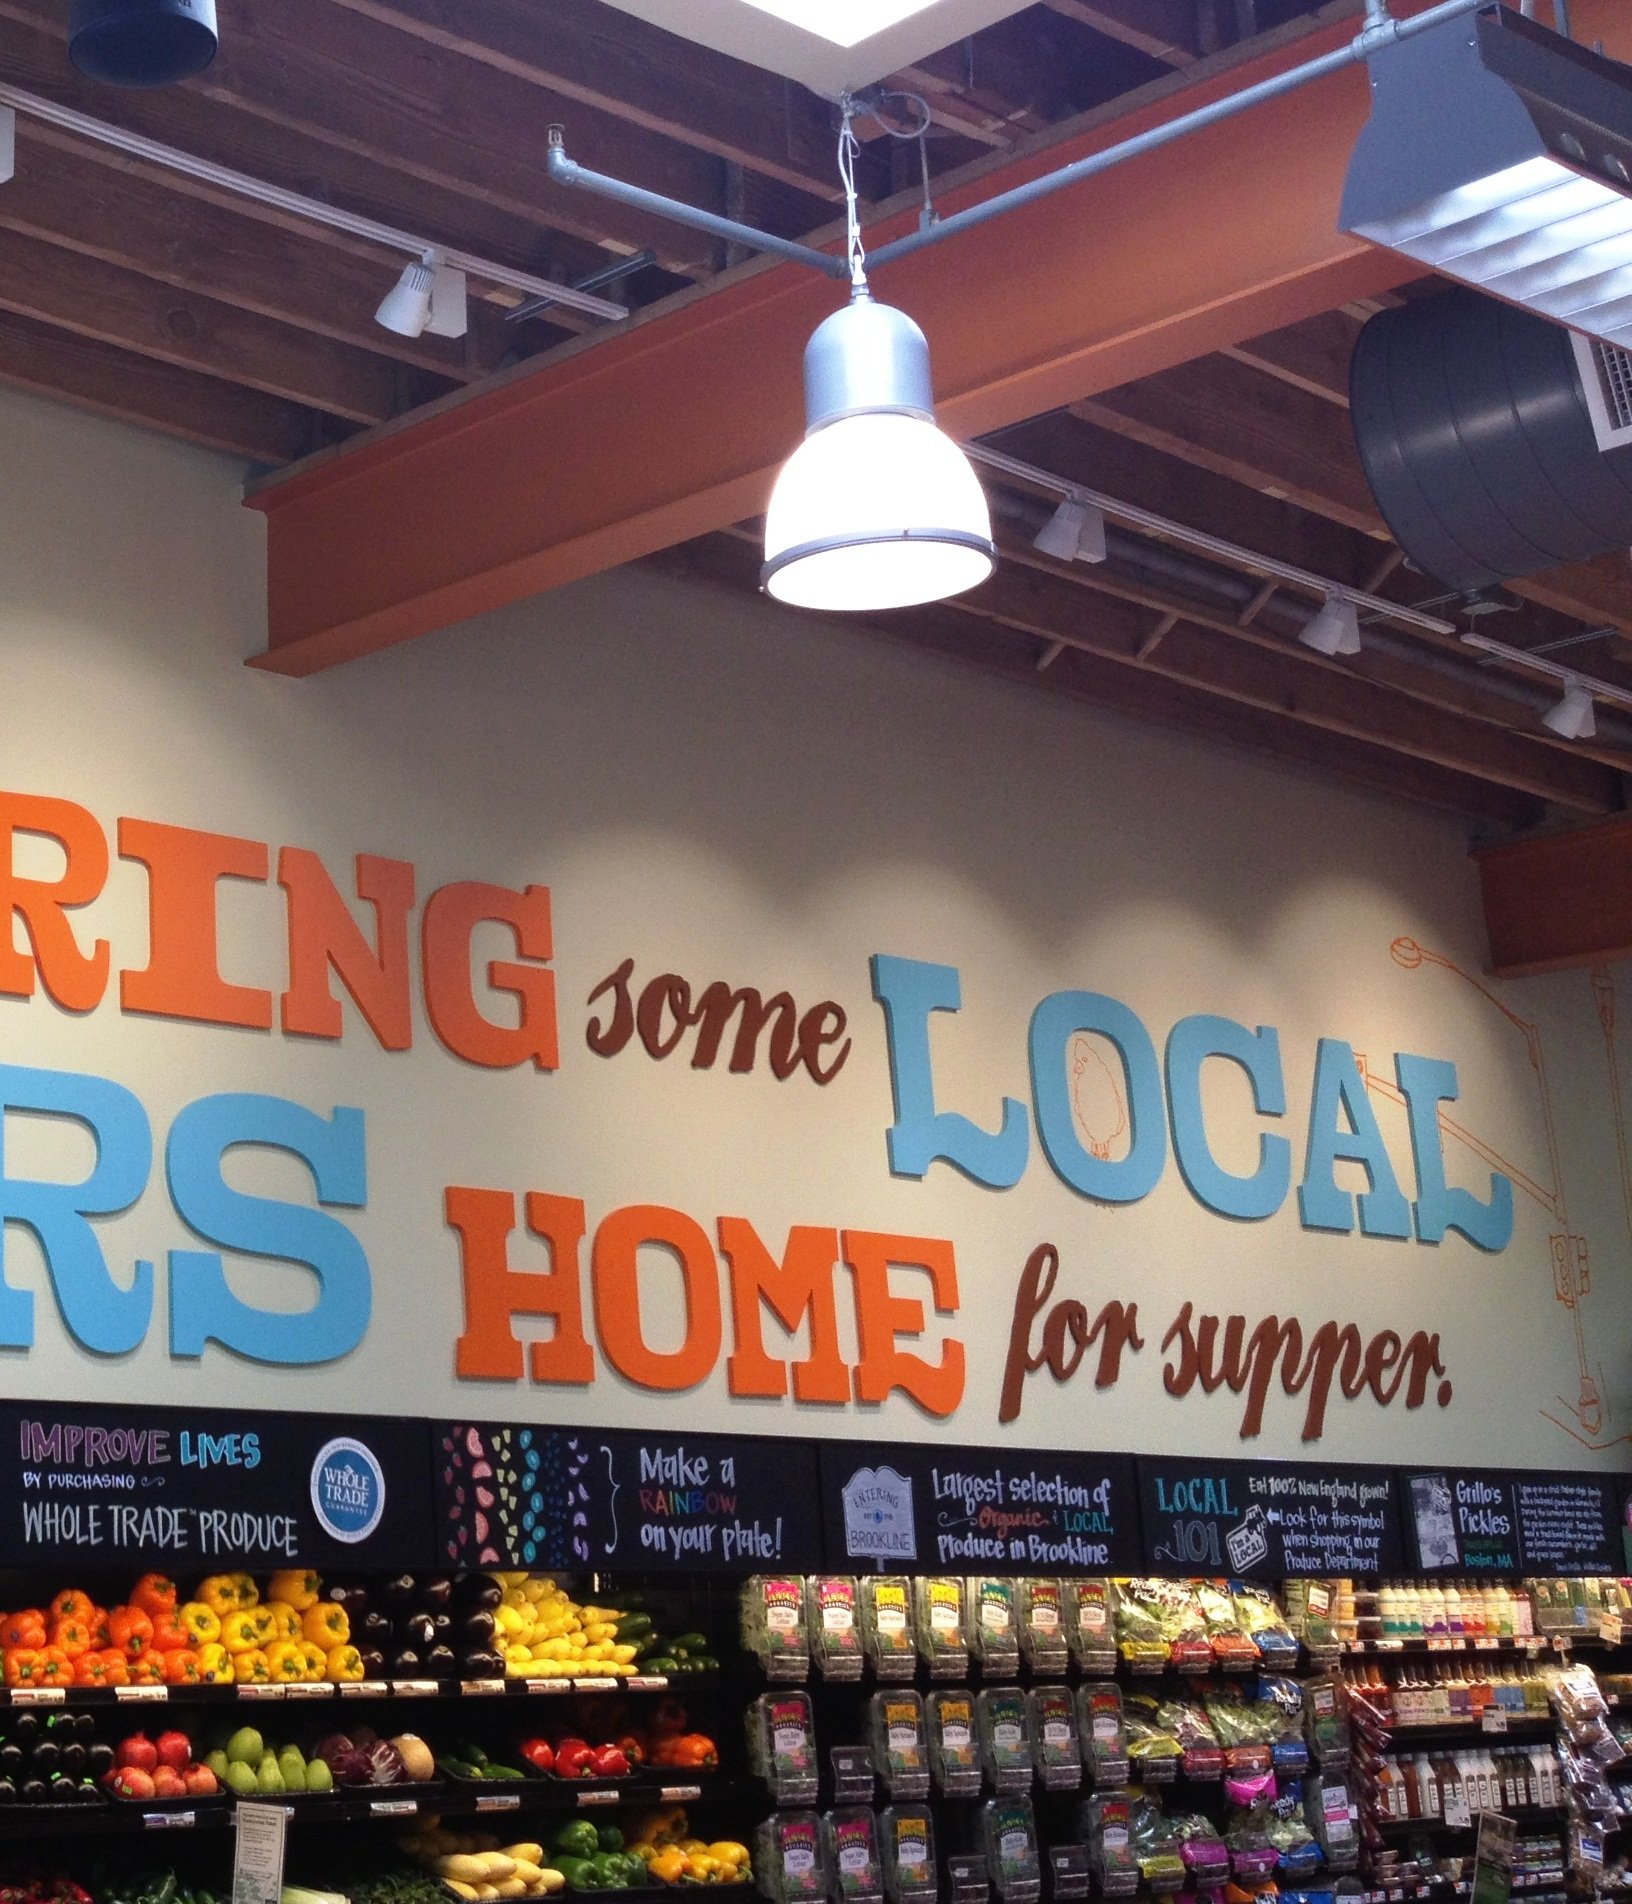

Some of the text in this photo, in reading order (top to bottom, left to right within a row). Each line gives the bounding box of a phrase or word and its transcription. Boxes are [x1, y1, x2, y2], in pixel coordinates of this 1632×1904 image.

[586, 958, 851, 1086] some
[870, 953, 1514, 1253] LOCAL
[444, 1186, 966, 1417] HOME
[999, 1243, 1144, 1424] for
[1161, 1301, 1454, 1442] supper.
[20, 1420, 261, 1468] IMPROVE LIVES
[23, 1472, 136, 1490] BY PURCHASING
[324, 1466, 370, 1491] WHOLE
[639, 1447, 735, 1487] Make a
[325, 1484, 369, 1508] TRADE
[639, 1490, 738, 1515] RAINBOW
[854, 1487, 899, 1508] ENTERING
[932, 1468, 1111, 1516] Largest selection of
[1155, 1477, 1238, 1517] LOCAL
[1249, 1477, 1267, 1494] Eat
[1268, 1476, 1297, 1496] 100%
[1298, 1480, 1319, 1497] New
[1319, 1478, 1357, 1508] England
[1456, 1480, 1502, 1504] Grillo's
[23, 1502, 102, 1544] WHOLE
[199, 1511, 298, 1557] PRODUCE
[978, 1506, 1050, 1539] Organic
[1063, 1510, 1114, 1535] LOCAL
[1280, 1505, 1385, 1535] Look for this symbol
[1459, 1507, 1510, 1535] Pickles
[640, 1517, 782, 1560] on your plate!
[850, 1530, 911, 1550] BROOKLINE
[1010, 1537, 1026, 1560] in
[1171, 1519, 1223, 1565] 101
[1282, 1529, 1309, 1548] when
[1309, 1530, 1352, 1557] shopping
[1364, 1536, 1381, 1549] our
[1284, 1550, 1379, 1572] Produce Department
